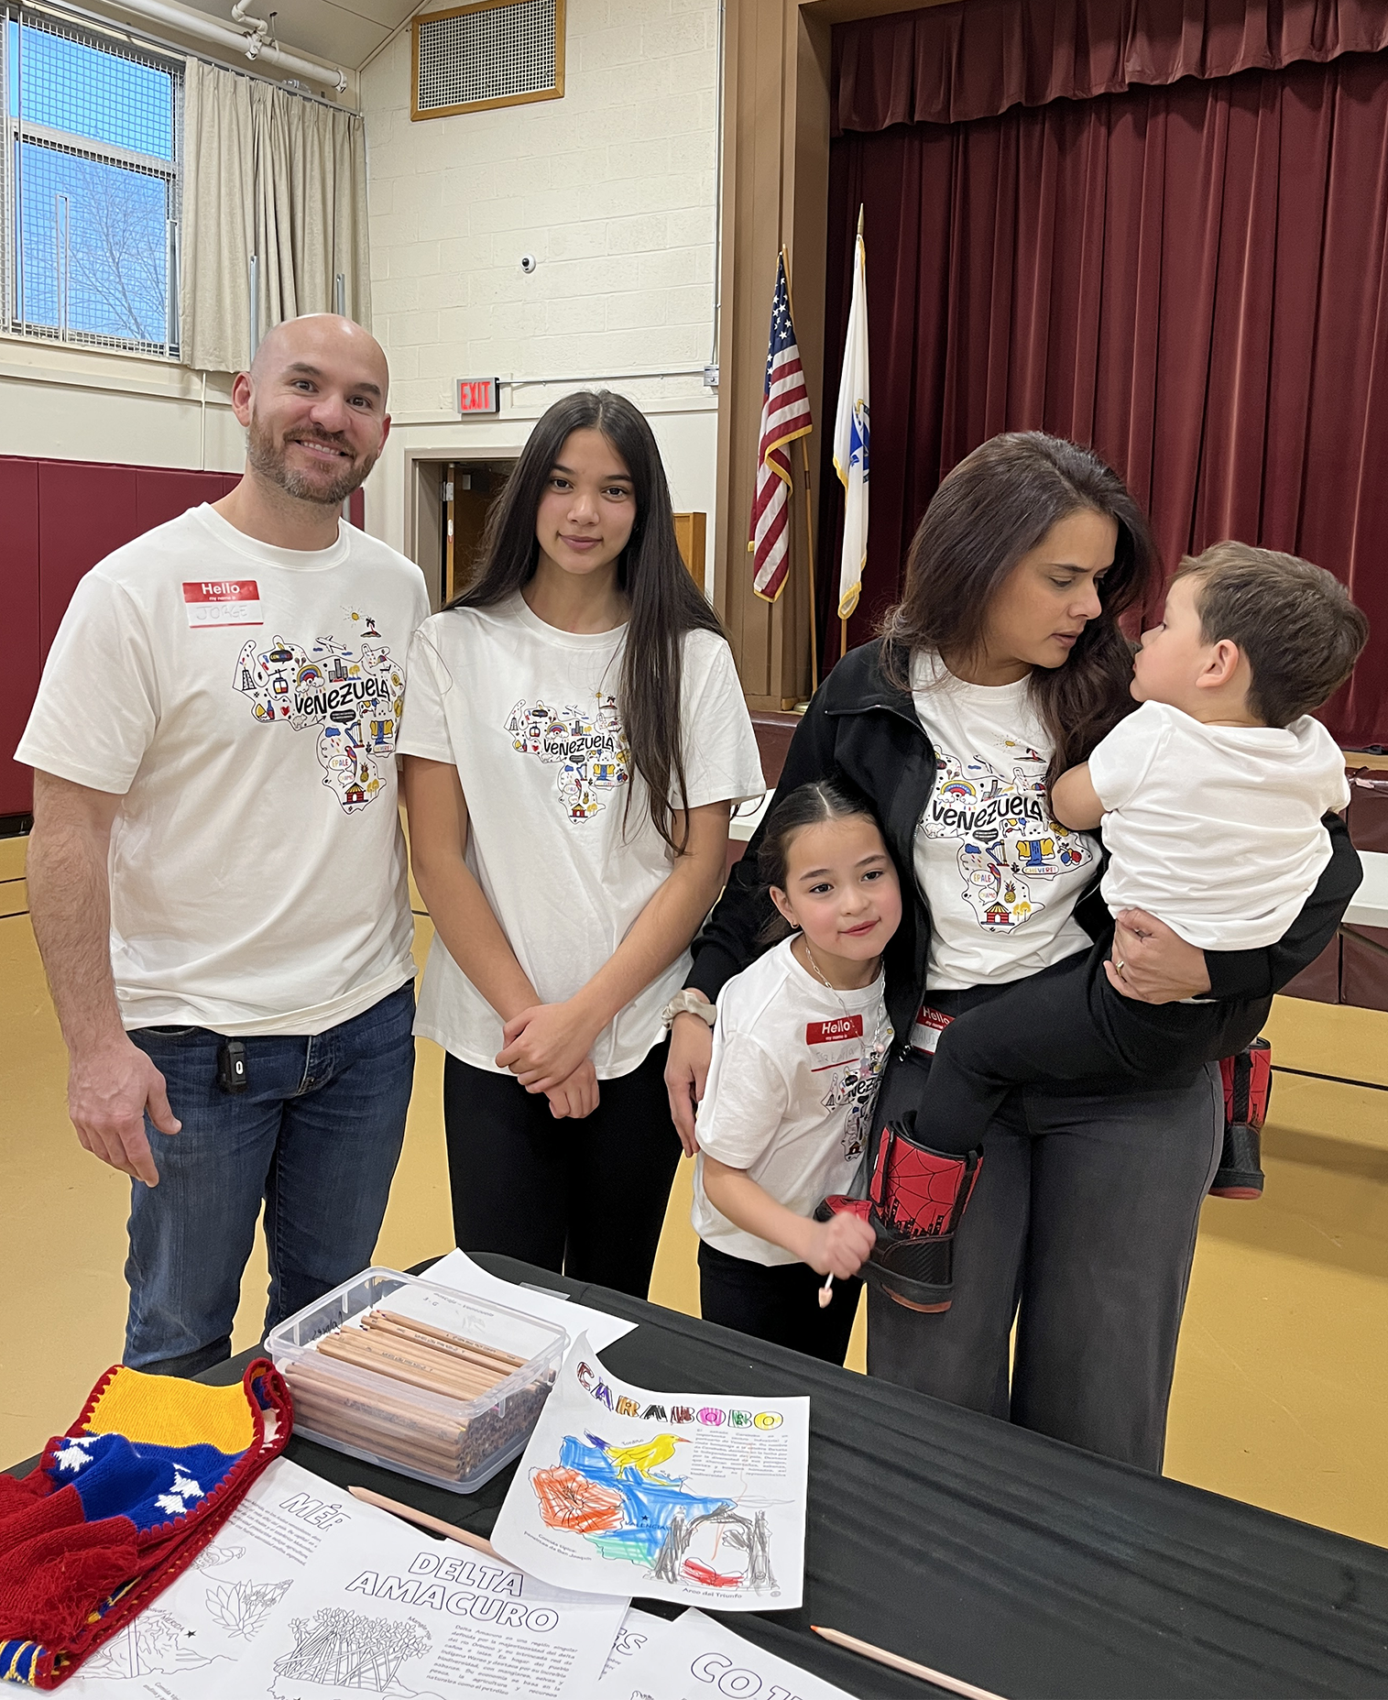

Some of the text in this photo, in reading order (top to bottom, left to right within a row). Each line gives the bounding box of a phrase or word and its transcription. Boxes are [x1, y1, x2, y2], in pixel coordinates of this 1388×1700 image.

[460, 381, 490, 410] EXIT
[202, 582, 240, 594] Hello
[196, 604, 248, 620] JORGE
[923, 1006, 950, 1025] Hello
[822, 1020, 850, 1034] Hello
[577, 1362, 784, 1430] CARABOBO
[624, 1520, 666, 1530] VALENCIA
[408, 1552, 524, 1598] DELTA
[346, 1571, 559, 1632] AMACURO
[475, 1630, 502, 1638] Amacuro
